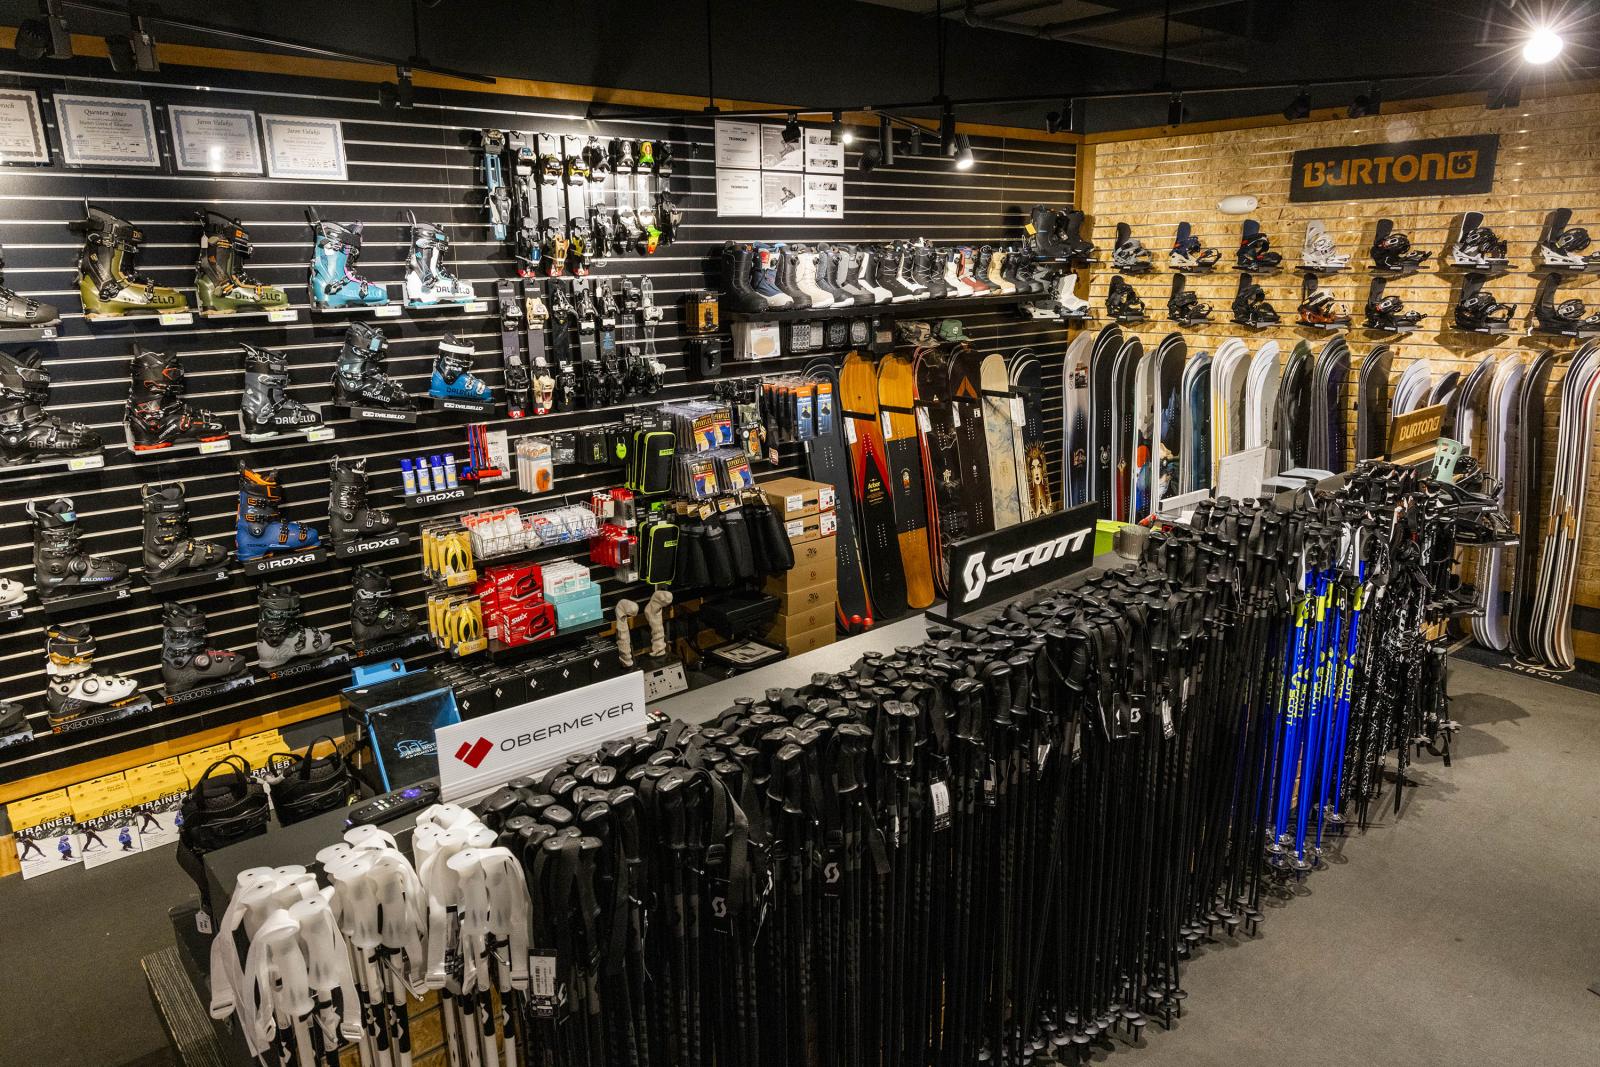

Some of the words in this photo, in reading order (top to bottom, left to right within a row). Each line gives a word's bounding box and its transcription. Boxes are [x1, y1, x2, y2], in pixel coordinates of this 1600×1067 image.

[1303, 152, 1446, 189] BURTON
[1399, 418, 1434, 442] BURTON
[986, 527, 1093, 583] SCOTT
[1499, 662, 1564, 681] ARBOR
[174, 687, 212, 704] SKIBOOTS
[1285, 688, 1298, 727] SCOTT
[62, 715, 105, 733] SKIBOOTS
[500, 701, 635, 753] OBERMEYER
[139, 791, 188, 811] TRAINER
[18, 816, 72, 838] TRAINER
[80, 808, 133, 829] TRAINER
